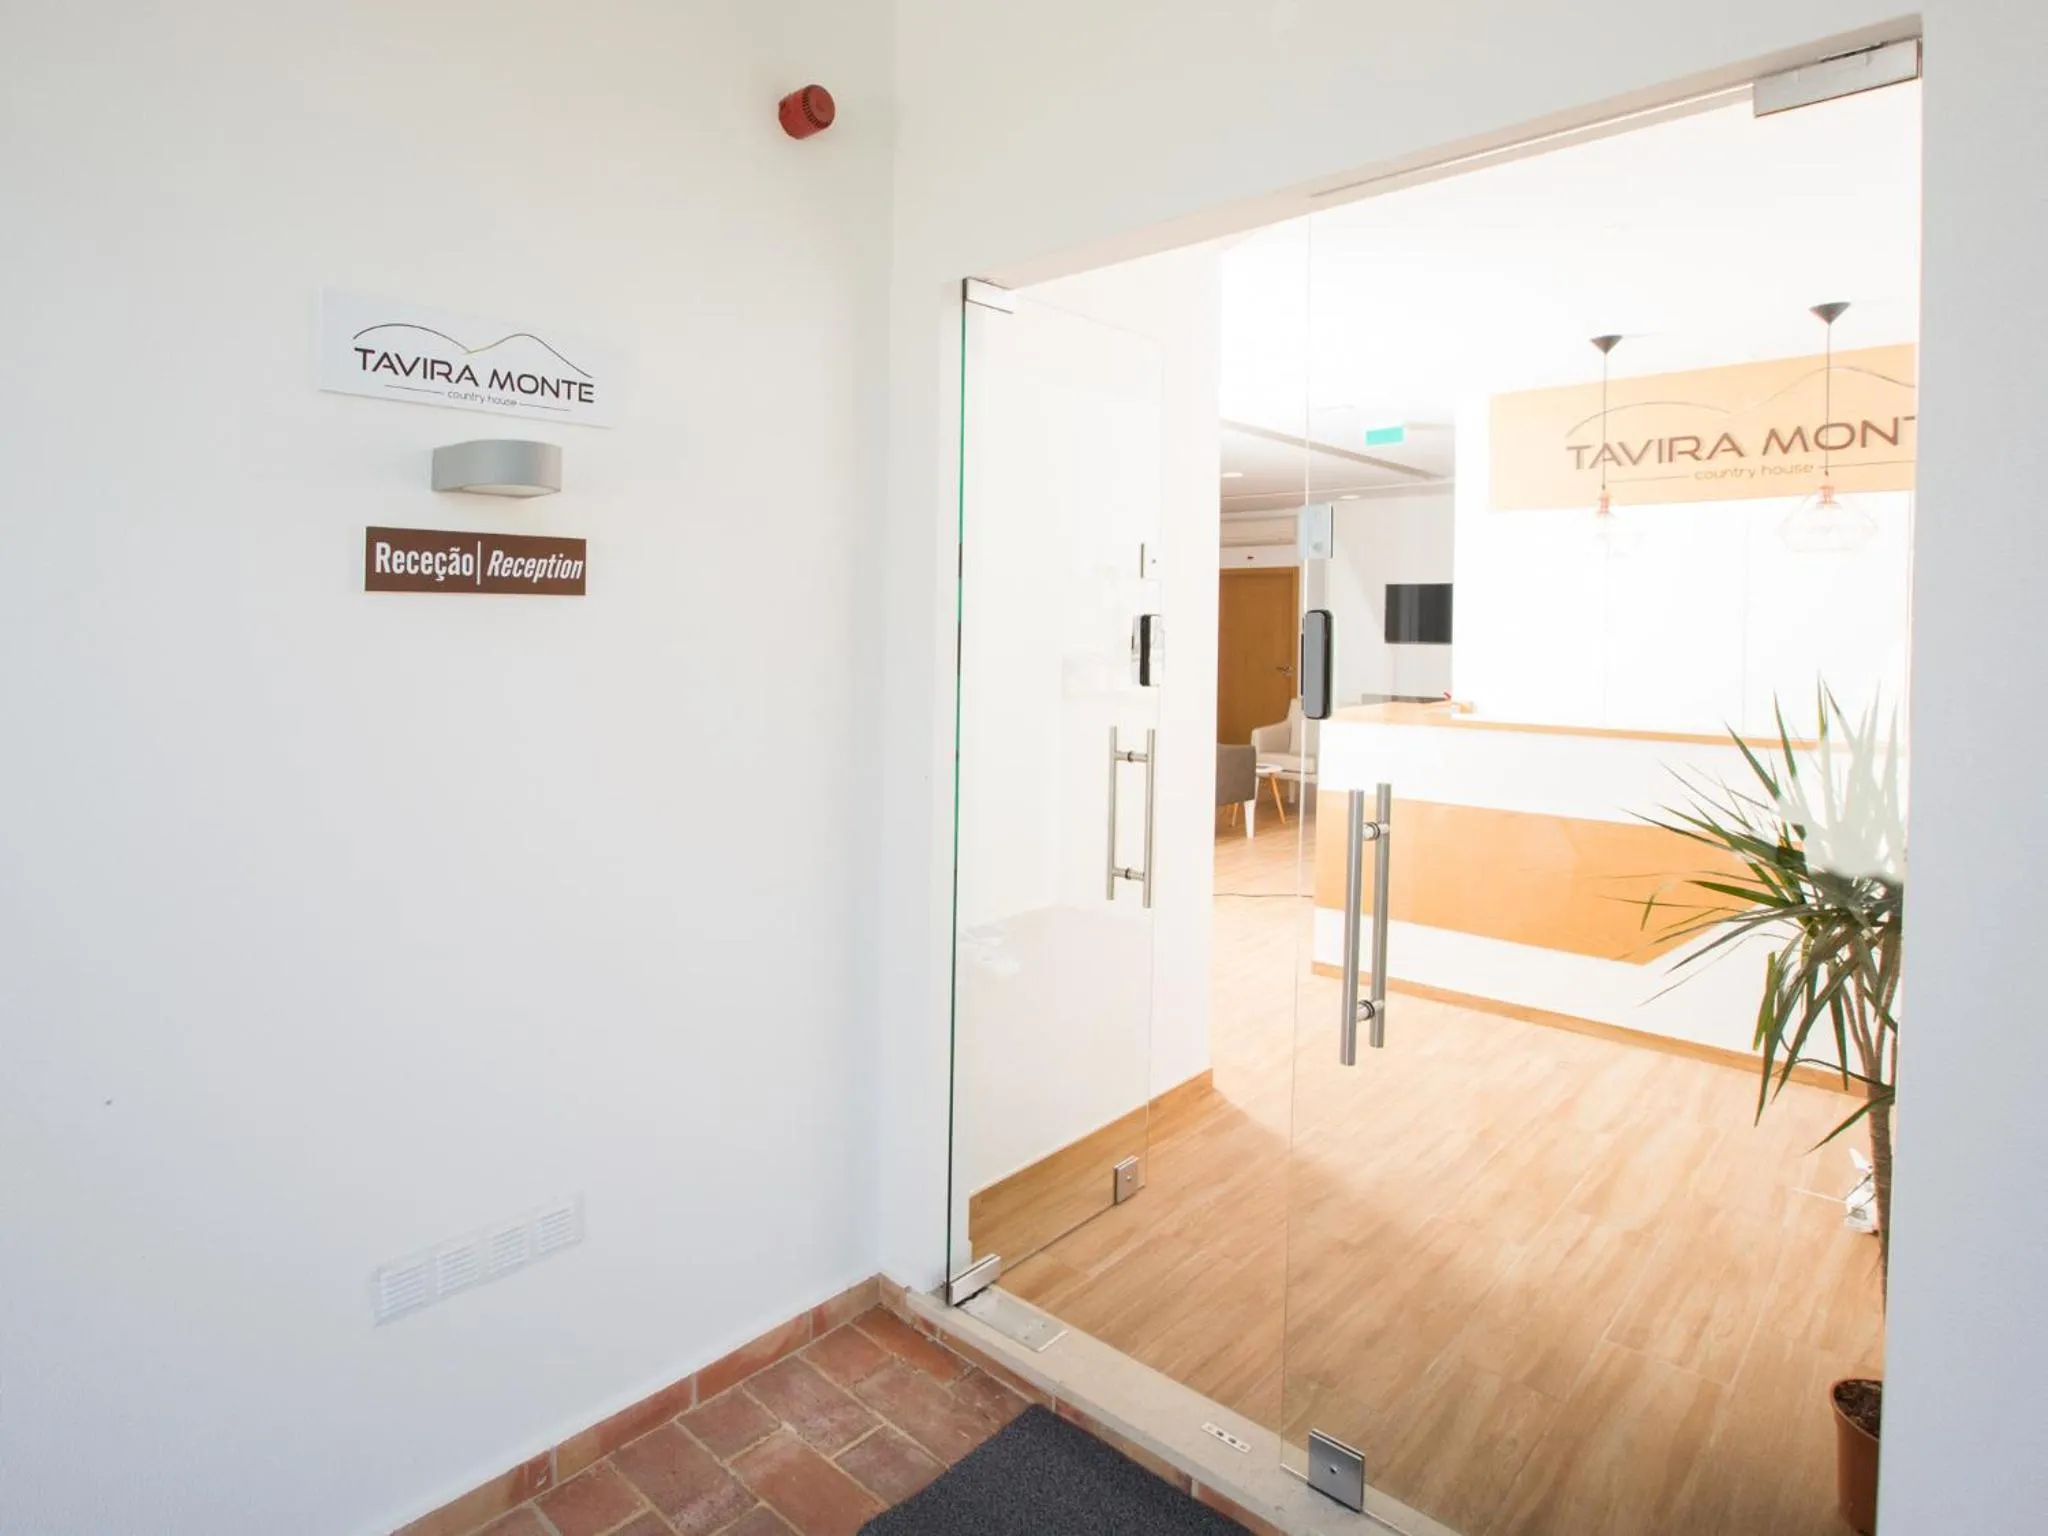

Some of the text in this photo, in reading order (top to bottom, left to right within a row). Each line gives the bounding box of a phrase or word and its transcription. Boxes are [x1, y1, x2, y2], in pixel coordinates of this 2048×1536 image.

[354, 347, 595, 404] TAVIRA MONTE
[447, 391, 517, 406] country house
[1566, 416, 1916, 471] TAVIRA MON
[1694, 463, 1814, 481] country house
[374, 541, 584, 583] Receção Reception
